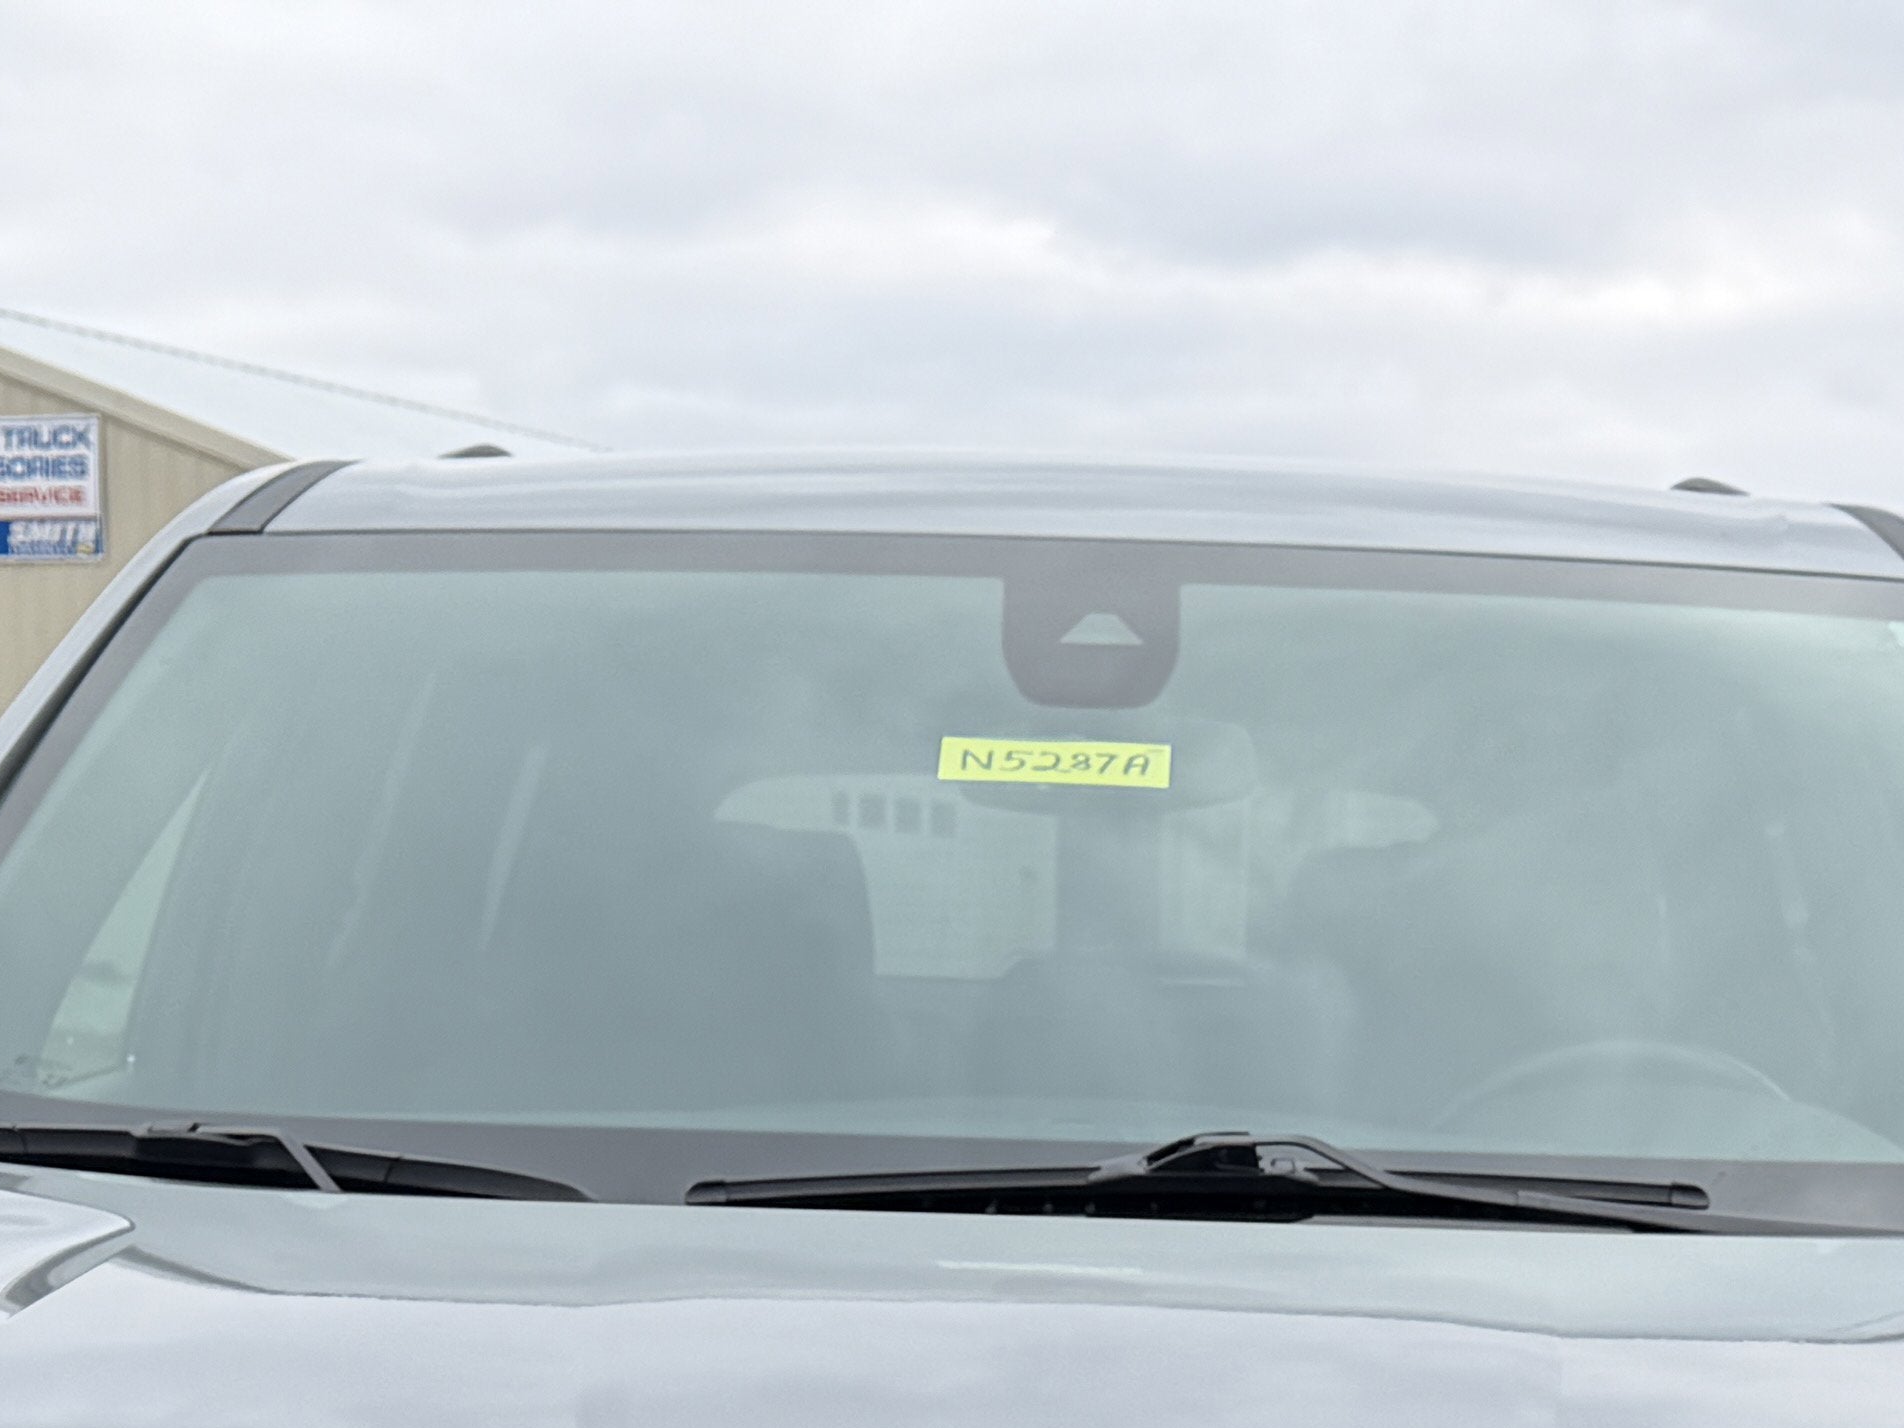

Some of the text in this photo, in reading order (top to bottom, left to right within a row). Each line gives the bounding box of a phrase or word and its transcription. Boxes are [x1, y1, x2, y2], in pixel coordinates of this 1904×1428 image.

[0, 424, 91, 449] TRUCK
[9, 520, 97, 543] SMITH
[961, 749, 1150, 777] N5287A
